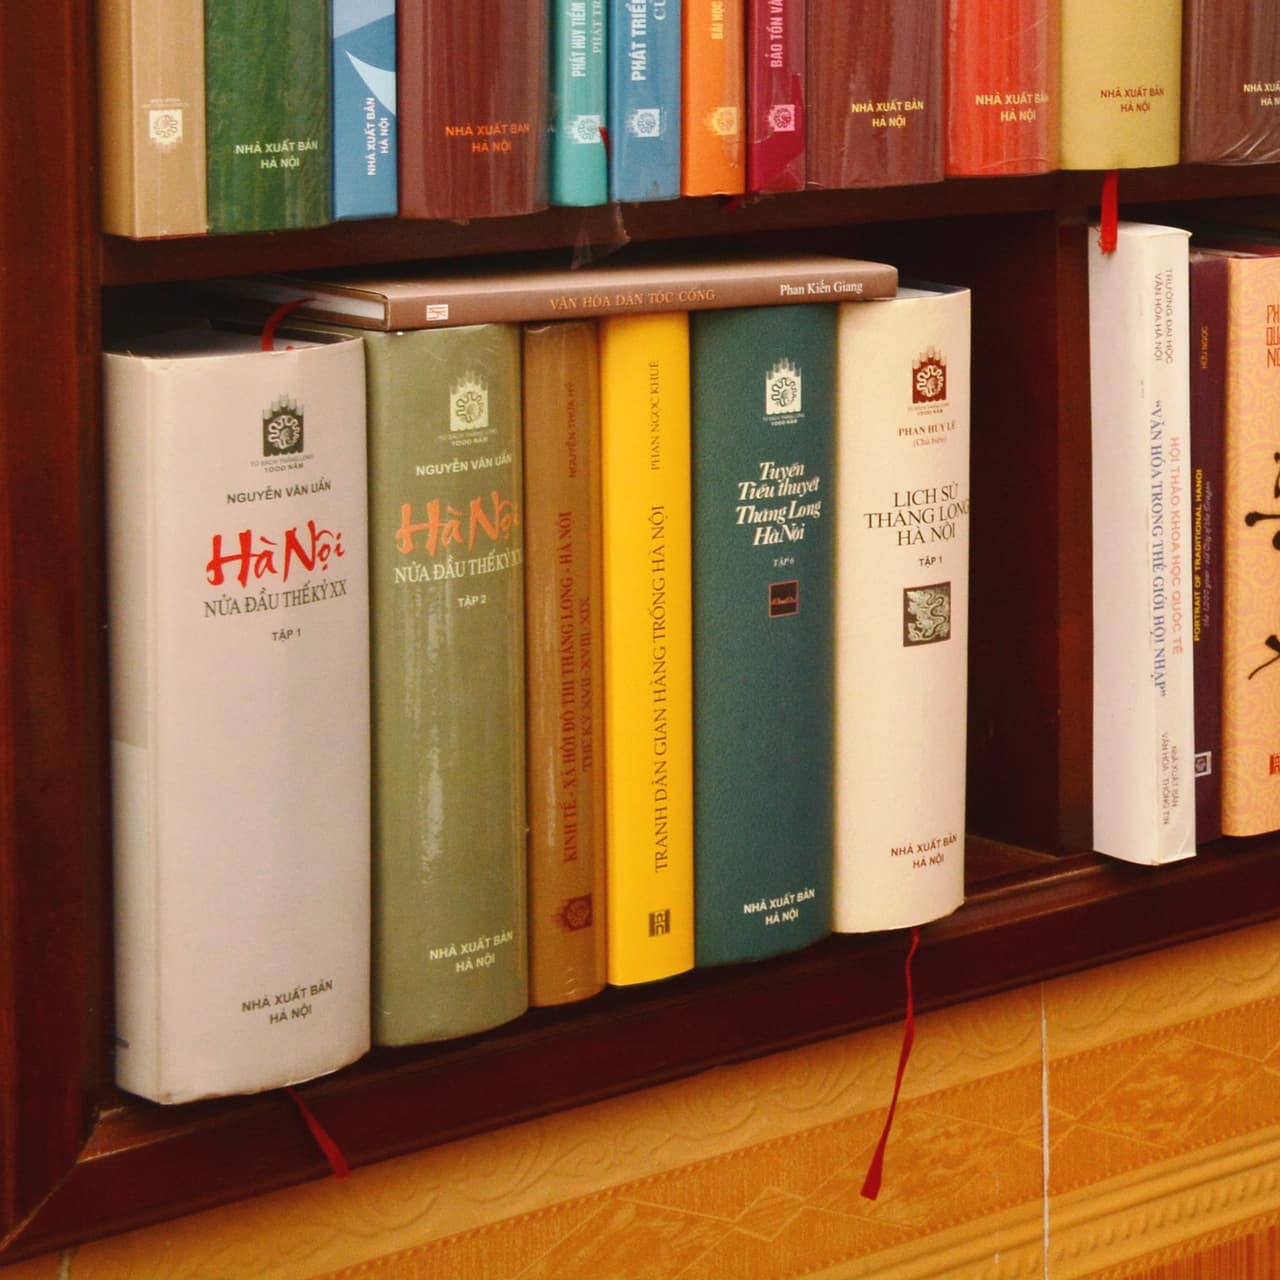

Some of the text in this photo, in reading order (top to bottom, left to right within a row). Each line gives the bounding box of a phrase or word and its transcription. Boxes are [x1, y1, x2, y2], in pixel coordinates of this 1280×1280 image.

[628, 42, 647, 81] PHÁT
[852, 101, 875, 112] NHÀ
[877, 100, 904, 113] XUẤT
[779, 277, 864, 297] Phan Kiến Giang
[1151, 446, 1167, 477] HÓA
[285, 482, 309, 500] VĂN
[649, 505, 668, 539] NỘI
[1152, 481, 1165, 537] TRONG
[897, 522, 956, 546] HÀ NỘI
[206, 519, 345, 588] Hà Nội
[650, 537, 666, 572] HÀ
[919, 556, 943, 569] TẬP 1
[1193, 469, 1204, 642] PORTRAIT OF TRADITIONAL HANOI
[271, 627, 301, 643] TẬP 1
[1150, 617, 1166, 644] HỘI
[652, 646, 668, 703] HÀNG
[654, 709, 669, 756] GIAN
[652, 760, 670, 802] DÂN
[655, 809, 671, 871] TRANH
